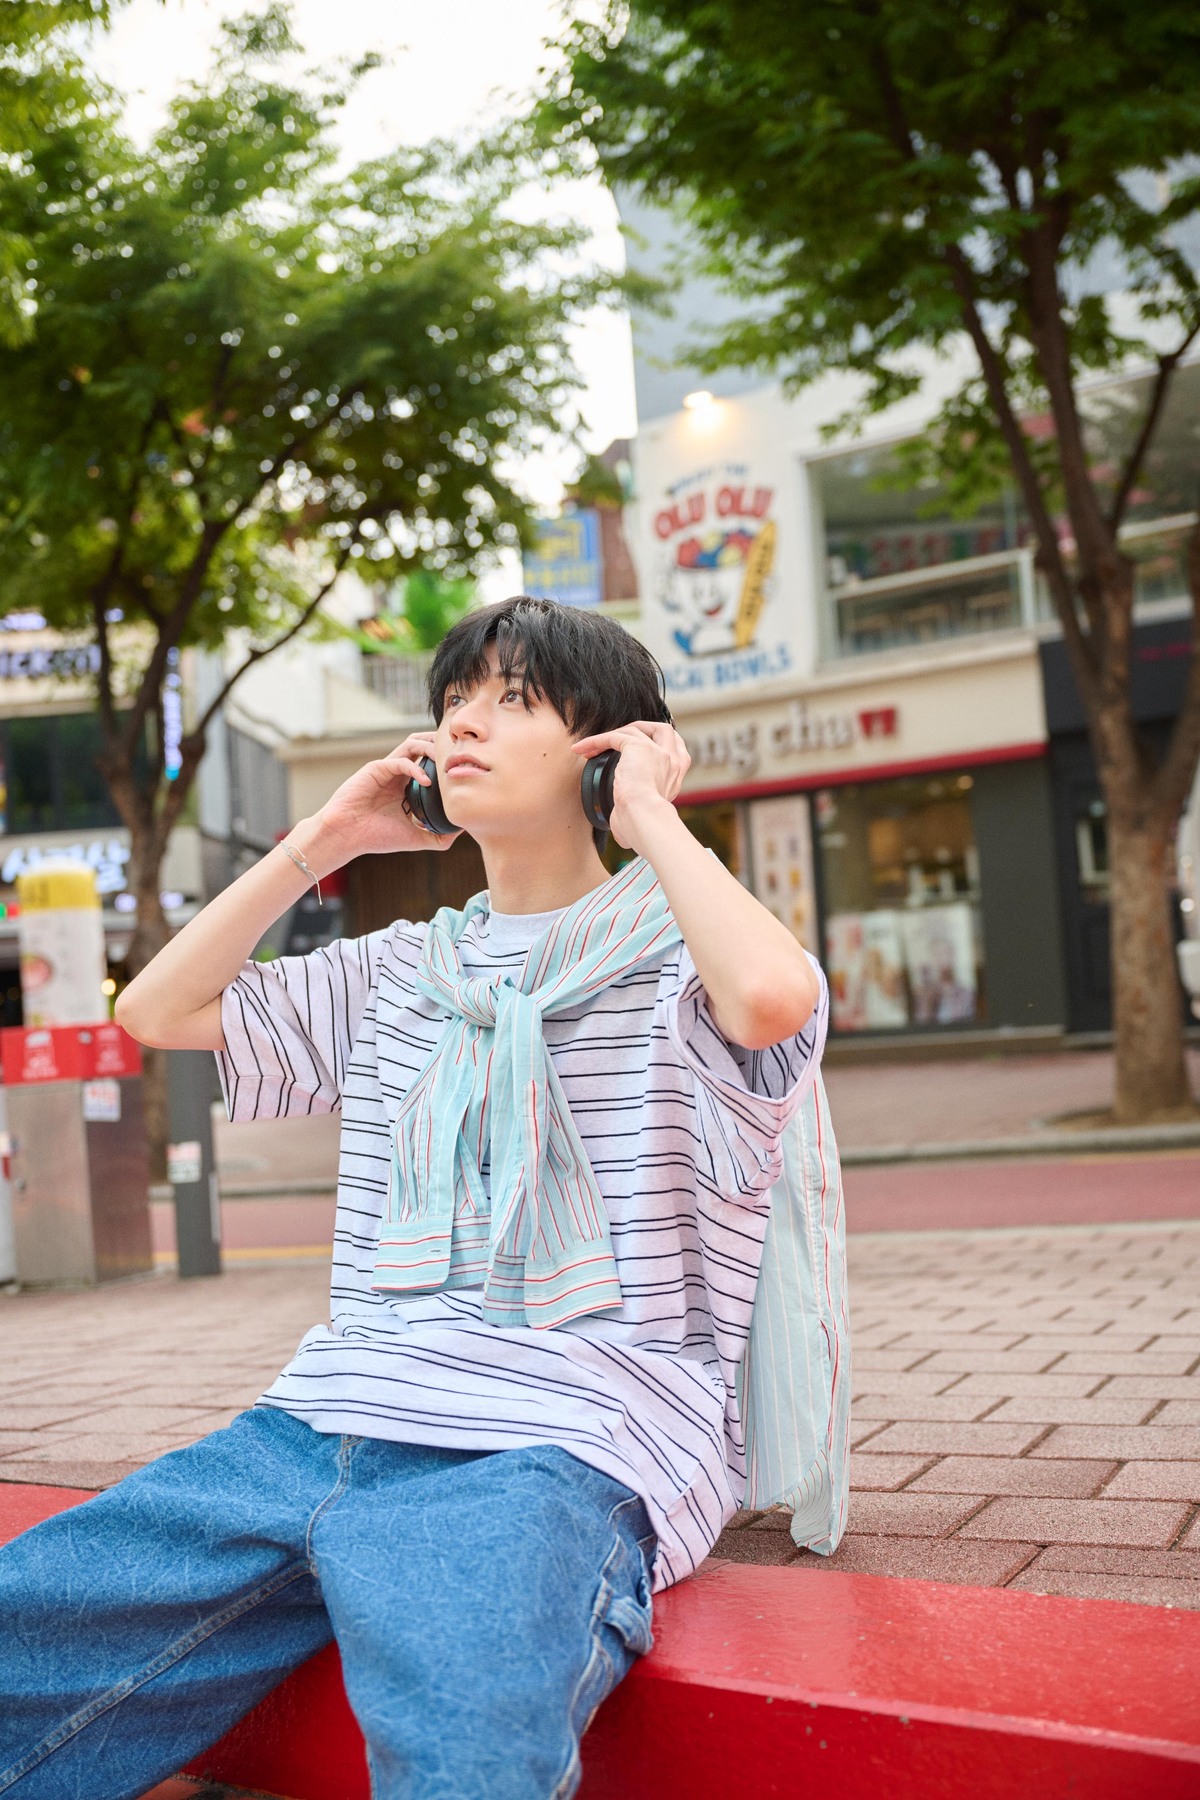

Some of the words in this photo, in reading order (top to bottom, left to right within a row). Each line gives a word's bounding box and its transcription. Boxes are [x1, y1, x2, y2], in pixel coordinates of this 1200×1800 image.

[654, 492, 706, 541] OLU
[716, 484, 774, 519] OLU
[716, 643, 791, 686] BOWLS
